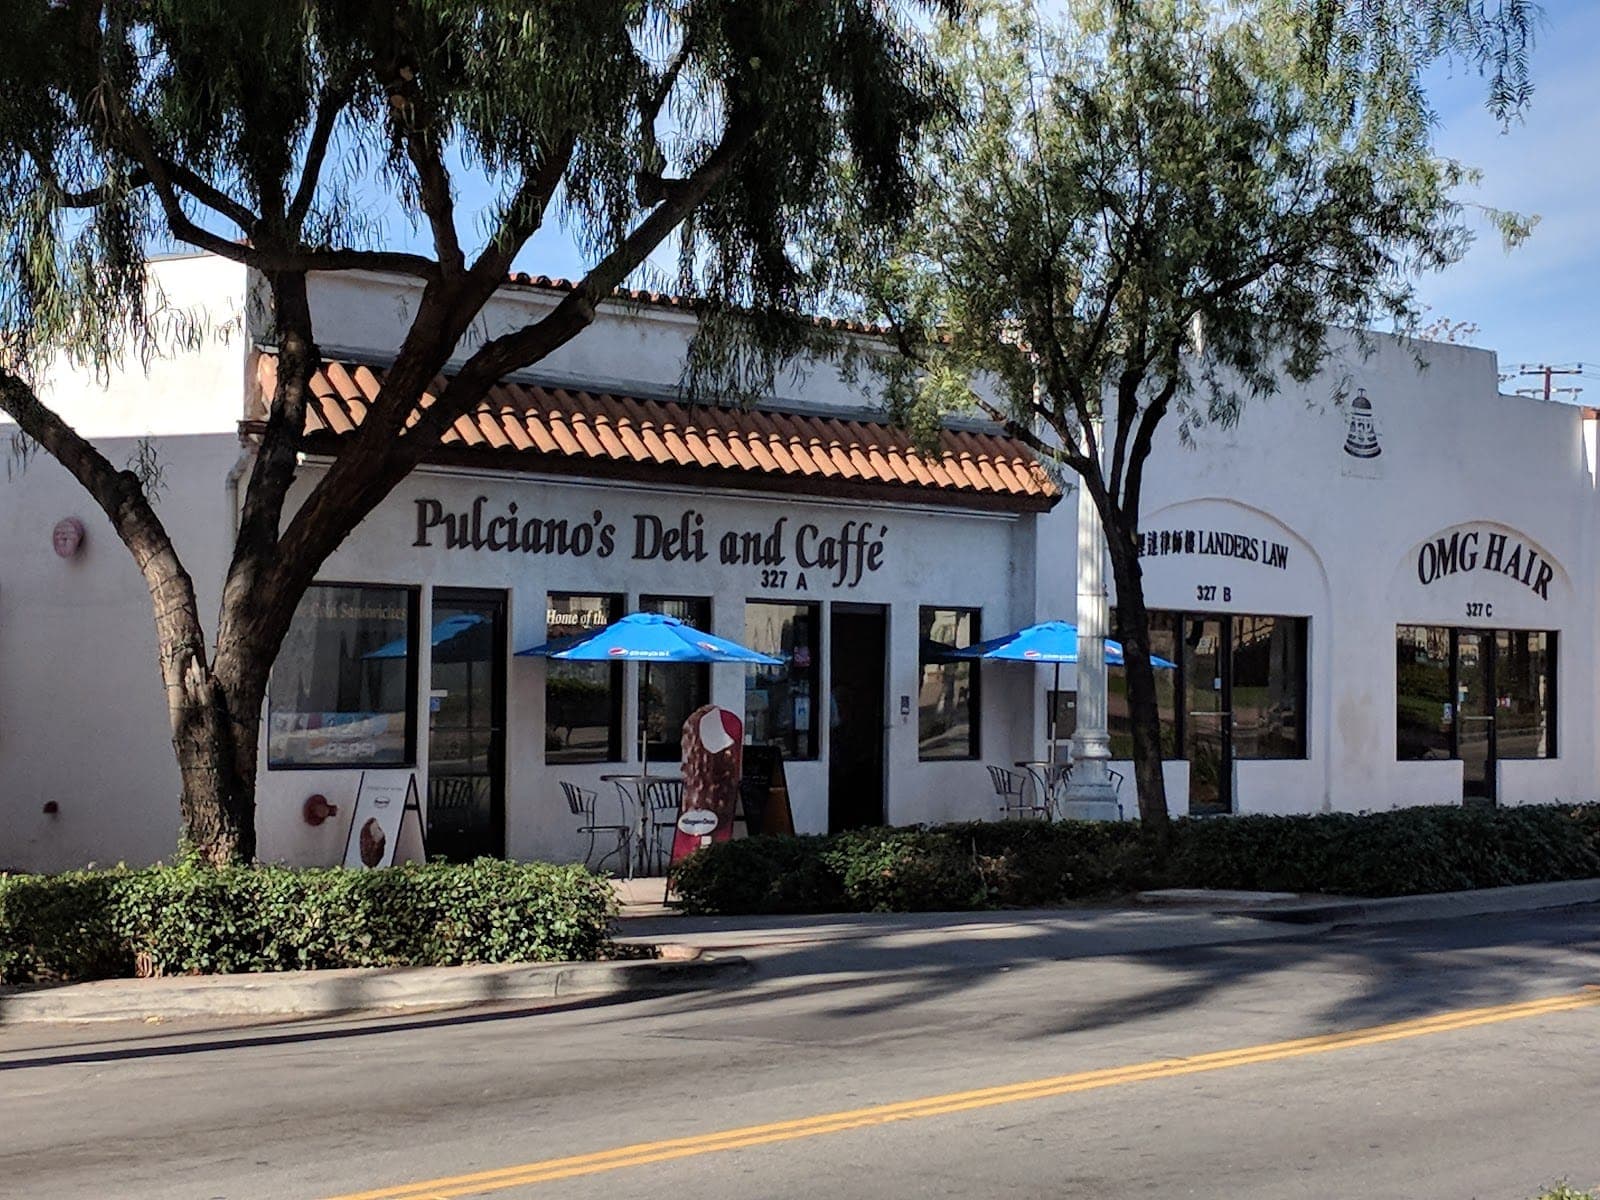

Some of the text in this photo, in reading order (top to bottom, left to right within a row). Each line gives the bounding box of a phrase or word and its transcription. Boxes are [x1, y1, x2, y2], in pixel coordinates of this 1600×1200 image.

[412, 496, 888, 588] Pulciano's Deli and Caffé
[1198, 530, 1258, 562] LANDERS
[1262, 540, 1289, 570] LAW
[1418, 532, 1553, 601] OMG HAIR
[761, 569, 809, 591] 327 A
[1197, 585, 1232, 602] 327 B
[547, 609, 578, 625] Home
[581, 609, 593, 628] of
[1466, 602, 1493, 617] 327 C
